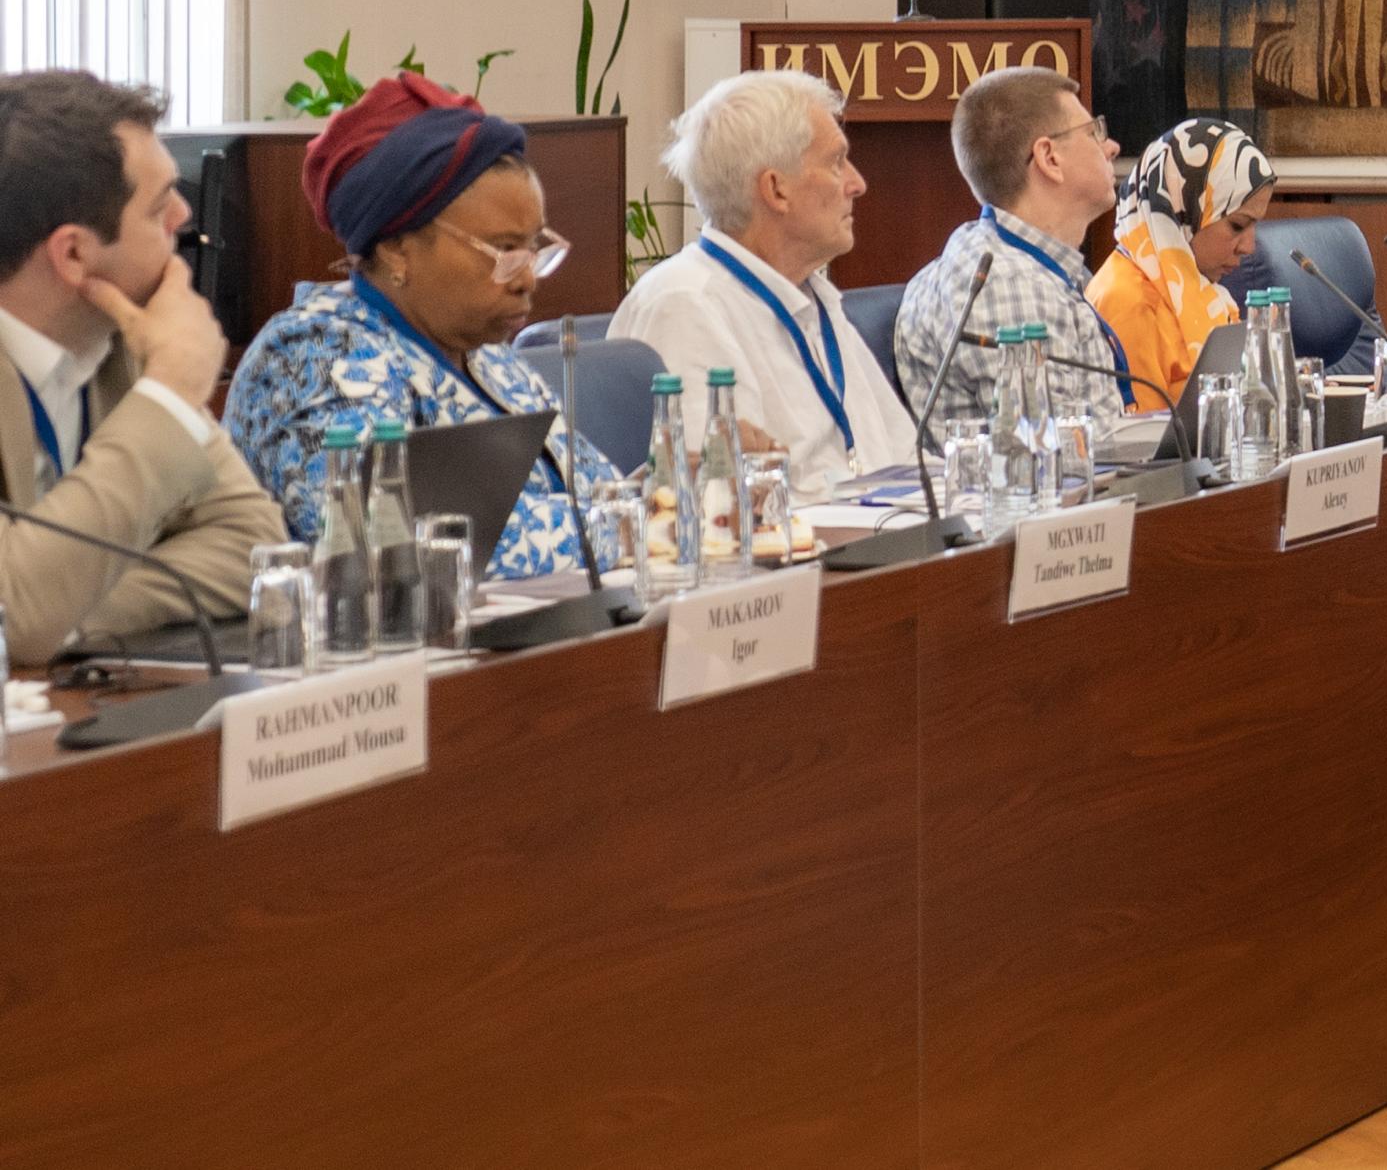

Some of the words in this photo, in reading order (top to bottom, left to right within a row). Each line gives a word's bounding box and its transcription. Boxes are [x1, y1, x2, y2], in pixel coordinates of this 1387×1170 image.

[1305, 454, 1368, 487] KUPRIYANOV
[1047, 522, 1105, 550] MGXWATI
[1033, 559, 1076, 584] Tandiwe
[1078, 553, 1113, 575] Thelma
[707, 591, 784, 630] MAKAROV
[731, 638, 759, 665] Igor
[255, 682, 399, 742] RAHMANPOOR
[247, 735, 348, 783] Mohammad
[353, 726, 407, 755] Mousa
